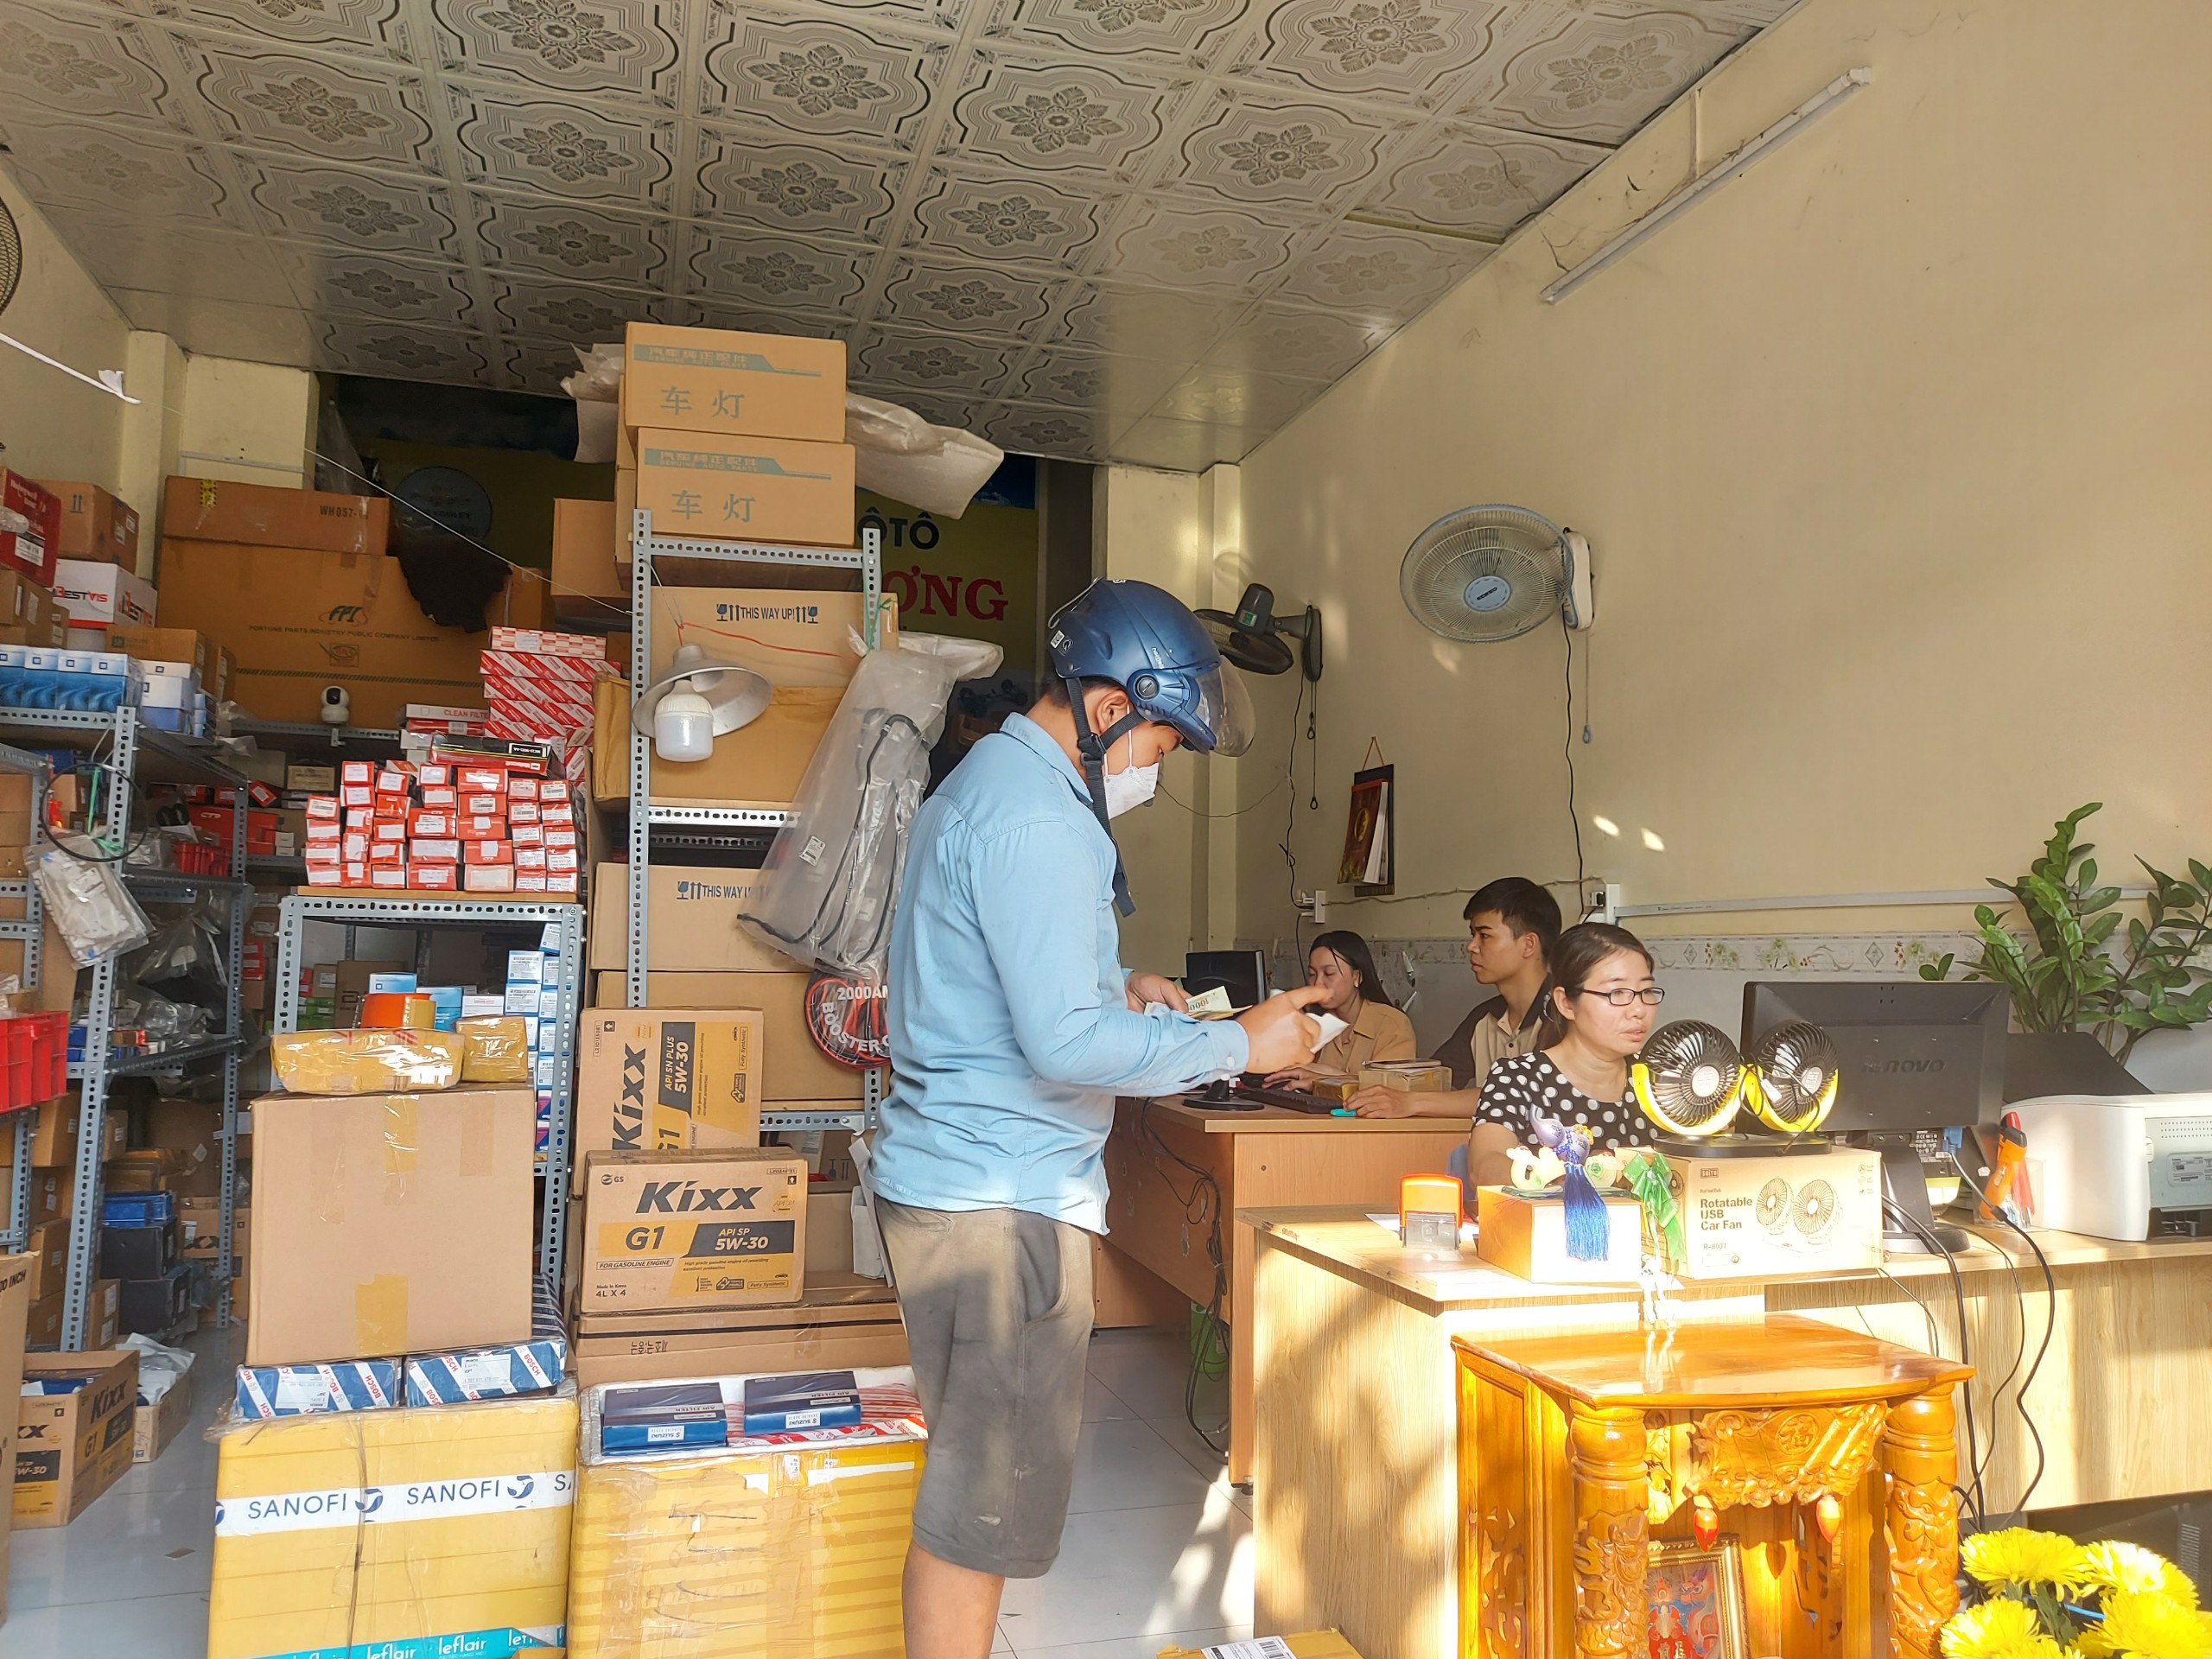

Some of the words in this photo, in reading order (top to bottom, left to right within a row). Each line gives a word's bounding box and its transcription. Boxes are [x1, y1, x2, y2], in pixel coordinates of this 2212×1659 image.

[703, 462, 726, 471] AUTO
[732, 464, 758, 473] PARTS
[327, 605, 363, 622] FPI
[741, 607, 760, 620] THIS
[761, 607, 780, 620] WAY
[781, 607, 795, 620] UP!
[374, 632, 410, 640] COMPANY
[443, 709, 468, 719] CLEAN
[702, 884, 721, 898] THIS
[723, 886, 743, 899] WAY
[822, 1001, 884, 1053] BOOSTER
[666, 1036, 675, 1058] PLUS
[665, 1060, 673, 1073] SN
[674, 1041, 690, 1093] 5W-30
[664, 1076, 673, 1090] API
[635, 1180, 763, 1214] Kixx
[1700, 1197, 1753, 1209] Rotatable
[1700, 1209, 1725, 1219] USB
[718, 1228, 736, 1236] API
[1700, 1221, 1720, 1230] Car
[1723, 1220, 1742, 1230] Fan
[626, 1225, 665, 1251] G1
[715, 1236, 769, 1251] 5W-30
[9, 1268, 27, 1288] INCH
[524, 1353, 542, 1376] BOSCH
[364, 1375, 382, 1399] BOSCH
[90, 1380, 128, 1425] Kixx
[247, 1492, 347, 1520] SANOFI
[406, 1479, 499, 1506] SANOFI
[438, 1637, 487, 1656] leflair
